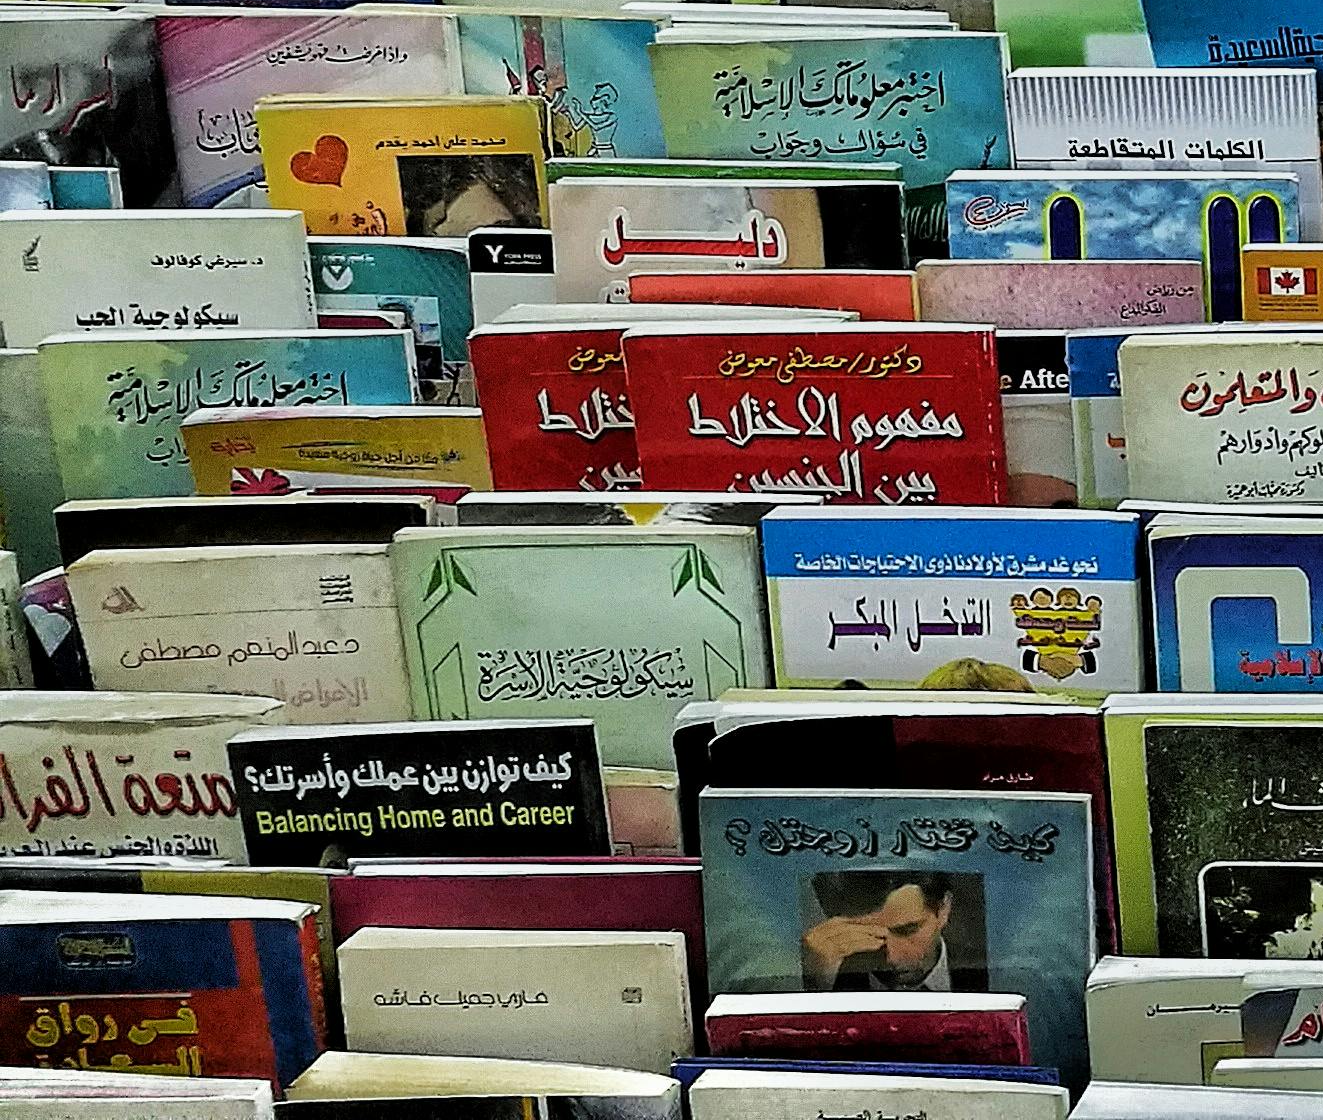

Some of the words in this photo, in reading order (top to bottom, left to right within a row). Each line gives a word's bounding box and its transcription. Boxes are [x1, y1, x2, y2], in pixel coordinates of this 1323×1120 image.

[1068, 140, 1175, 160] المتقاطعة
[1183, 140, 1265, 158] الكلمات
[688, 386, 841, 448] الاختلاط
[850, 401, 963, 450] مفهوم
[347, 760, 418, 788] عملك
[424, 760, 459, 793] بين
[522, 752, 571, 788] كيف
[256, 807, 373, 834] Balancing
[378, 807, 446, 830] Home
[453, 804, 493, 829] and
[500, 803, 574, 826] Career
